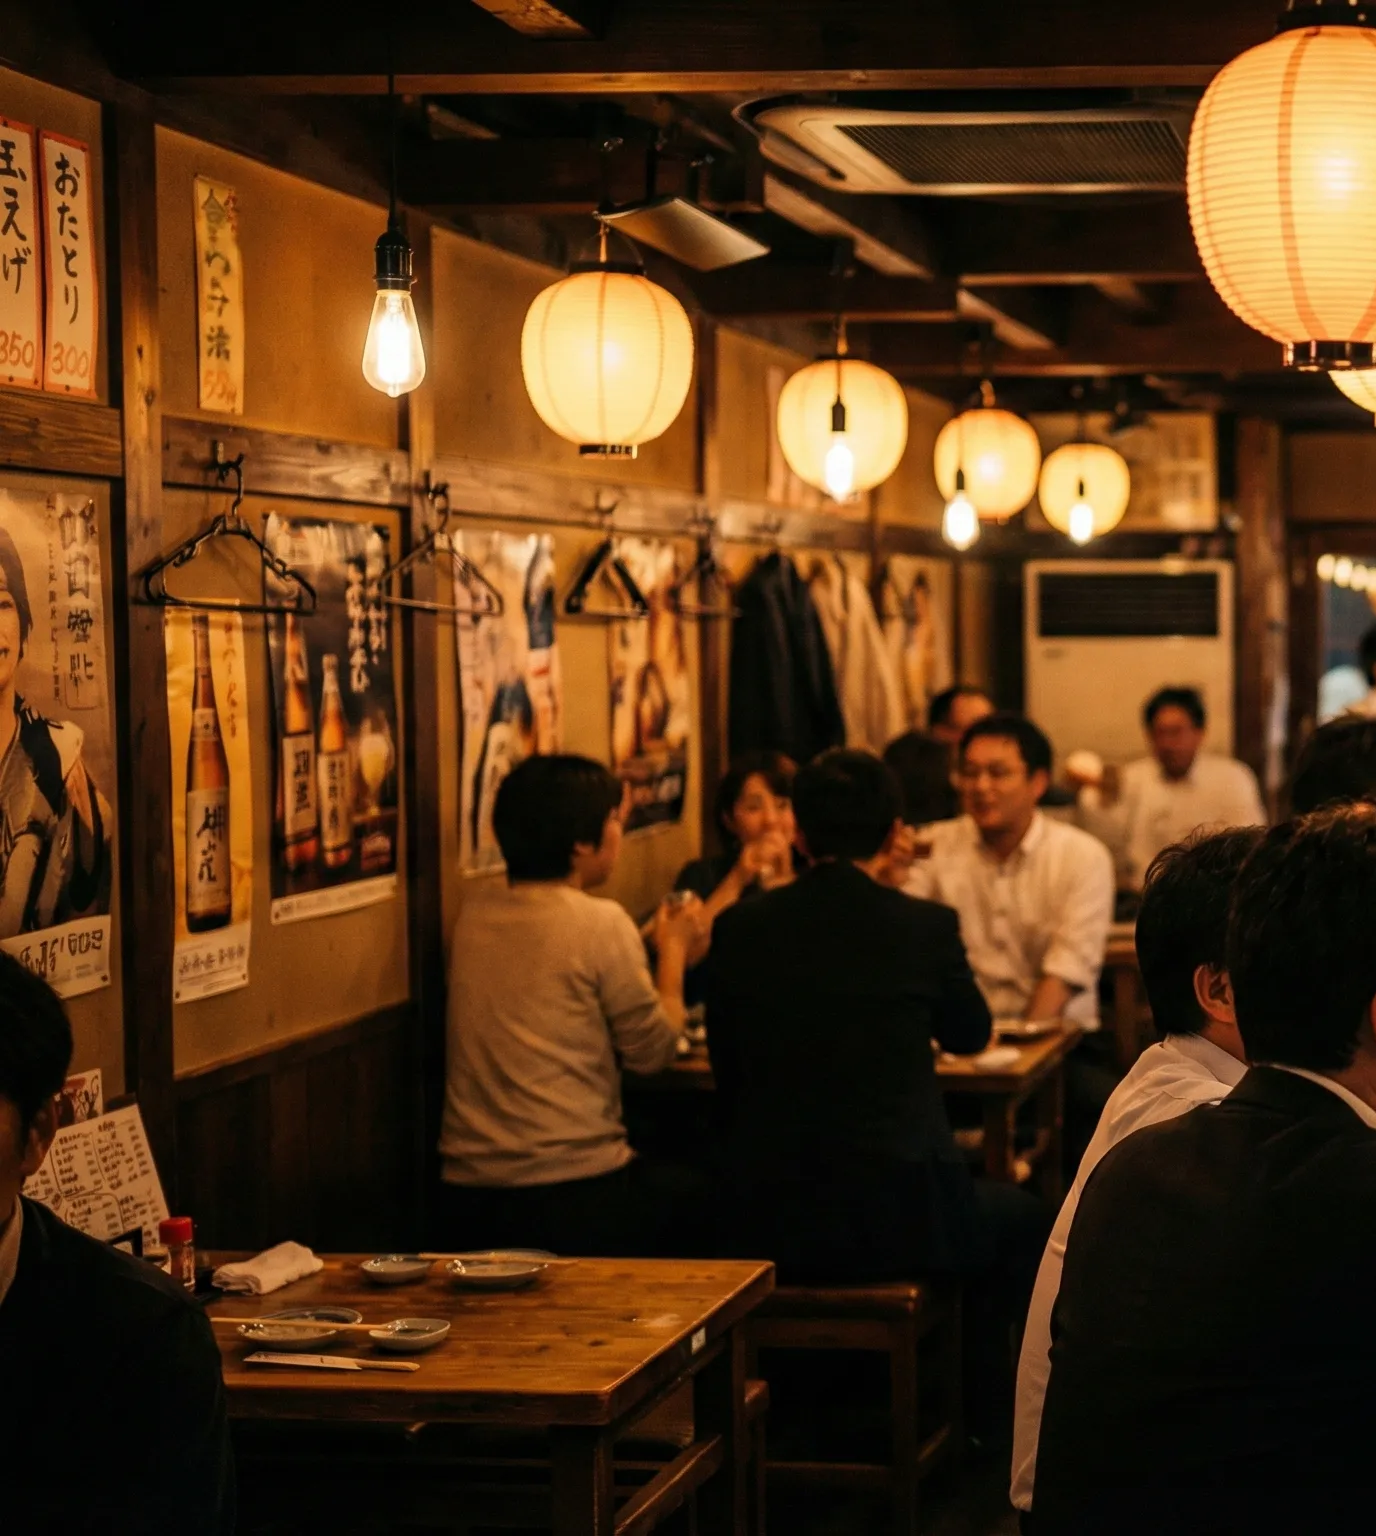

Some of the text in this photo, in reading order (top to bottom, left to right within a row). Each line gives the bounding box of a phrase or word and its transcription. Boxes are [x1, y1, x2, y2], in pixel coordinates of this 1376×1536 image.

[54, 152, 80, 325] おたとり
[51, 341, 89, 379] 300
